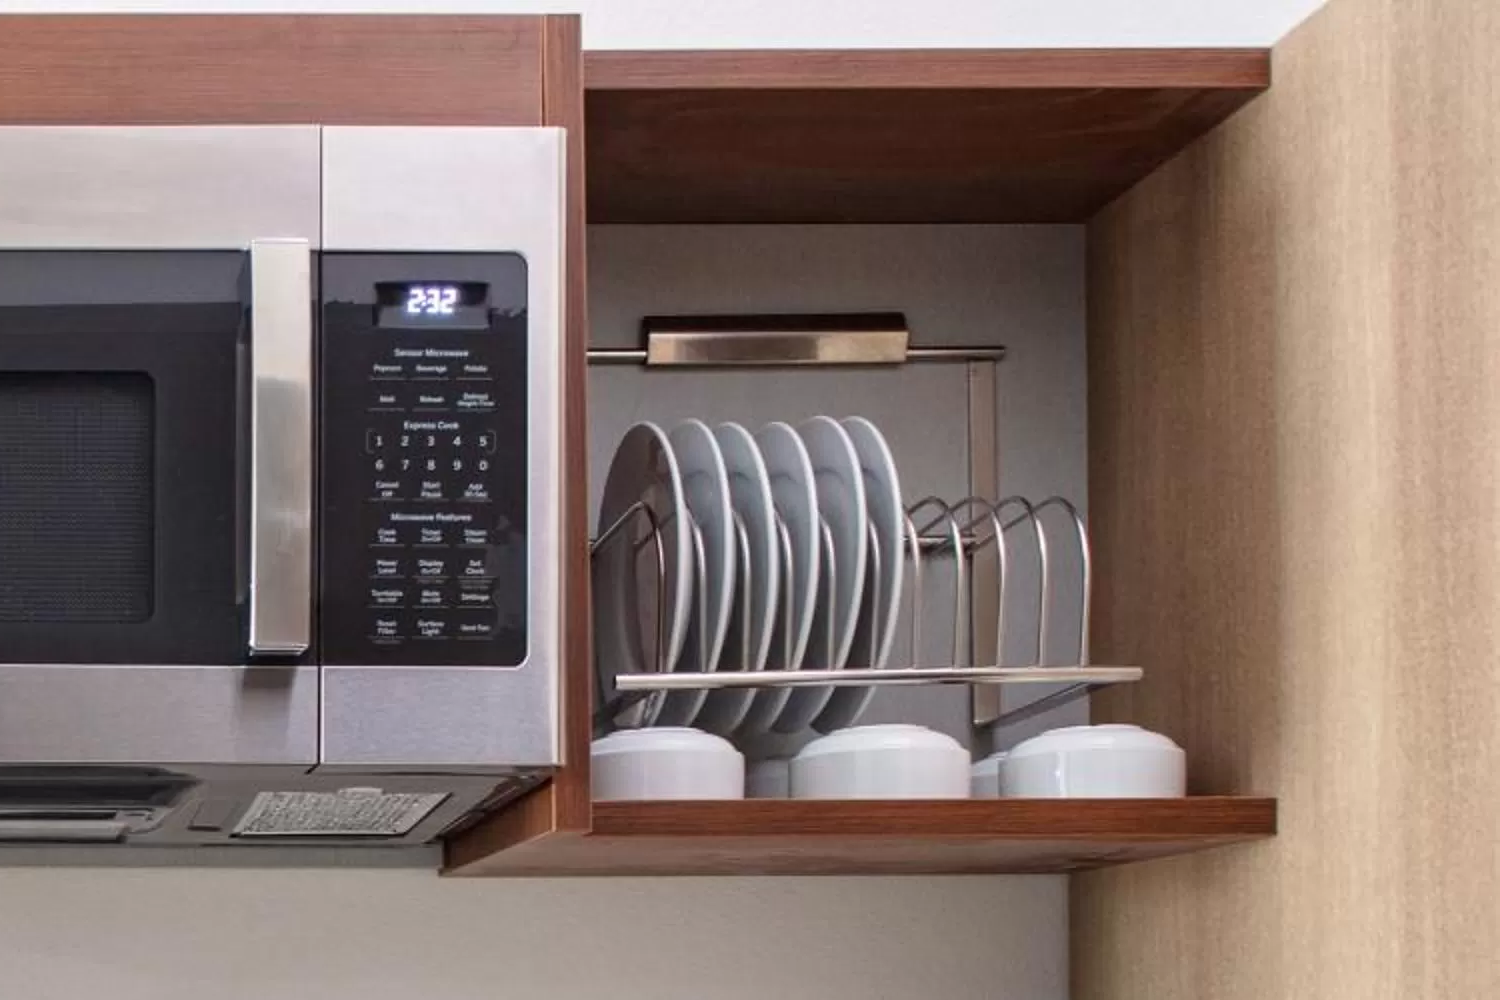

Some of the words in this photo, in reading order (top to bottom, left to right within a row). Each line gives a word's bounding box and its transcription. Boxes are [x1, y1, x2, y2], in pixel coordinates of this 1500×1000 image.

[407, 287, 458, 314] 2:32
[425, 348, 469, 357] Microwave
[403, 421, 436, 431] Express
[375, 436, 383, 447] 1
[400, 436, 409, 447] 2
[427, 436, 435, 447] 3
[453, 436, 461, 447] 4
[479, 436, 488, 447] 5
[375, 459, 384, 471] 6
[402, 459, 410, 471] 7
[427, 459, 436, 471] 8
[453, 459, 462, 471] 9
[479, 459, 488, 471] 0
